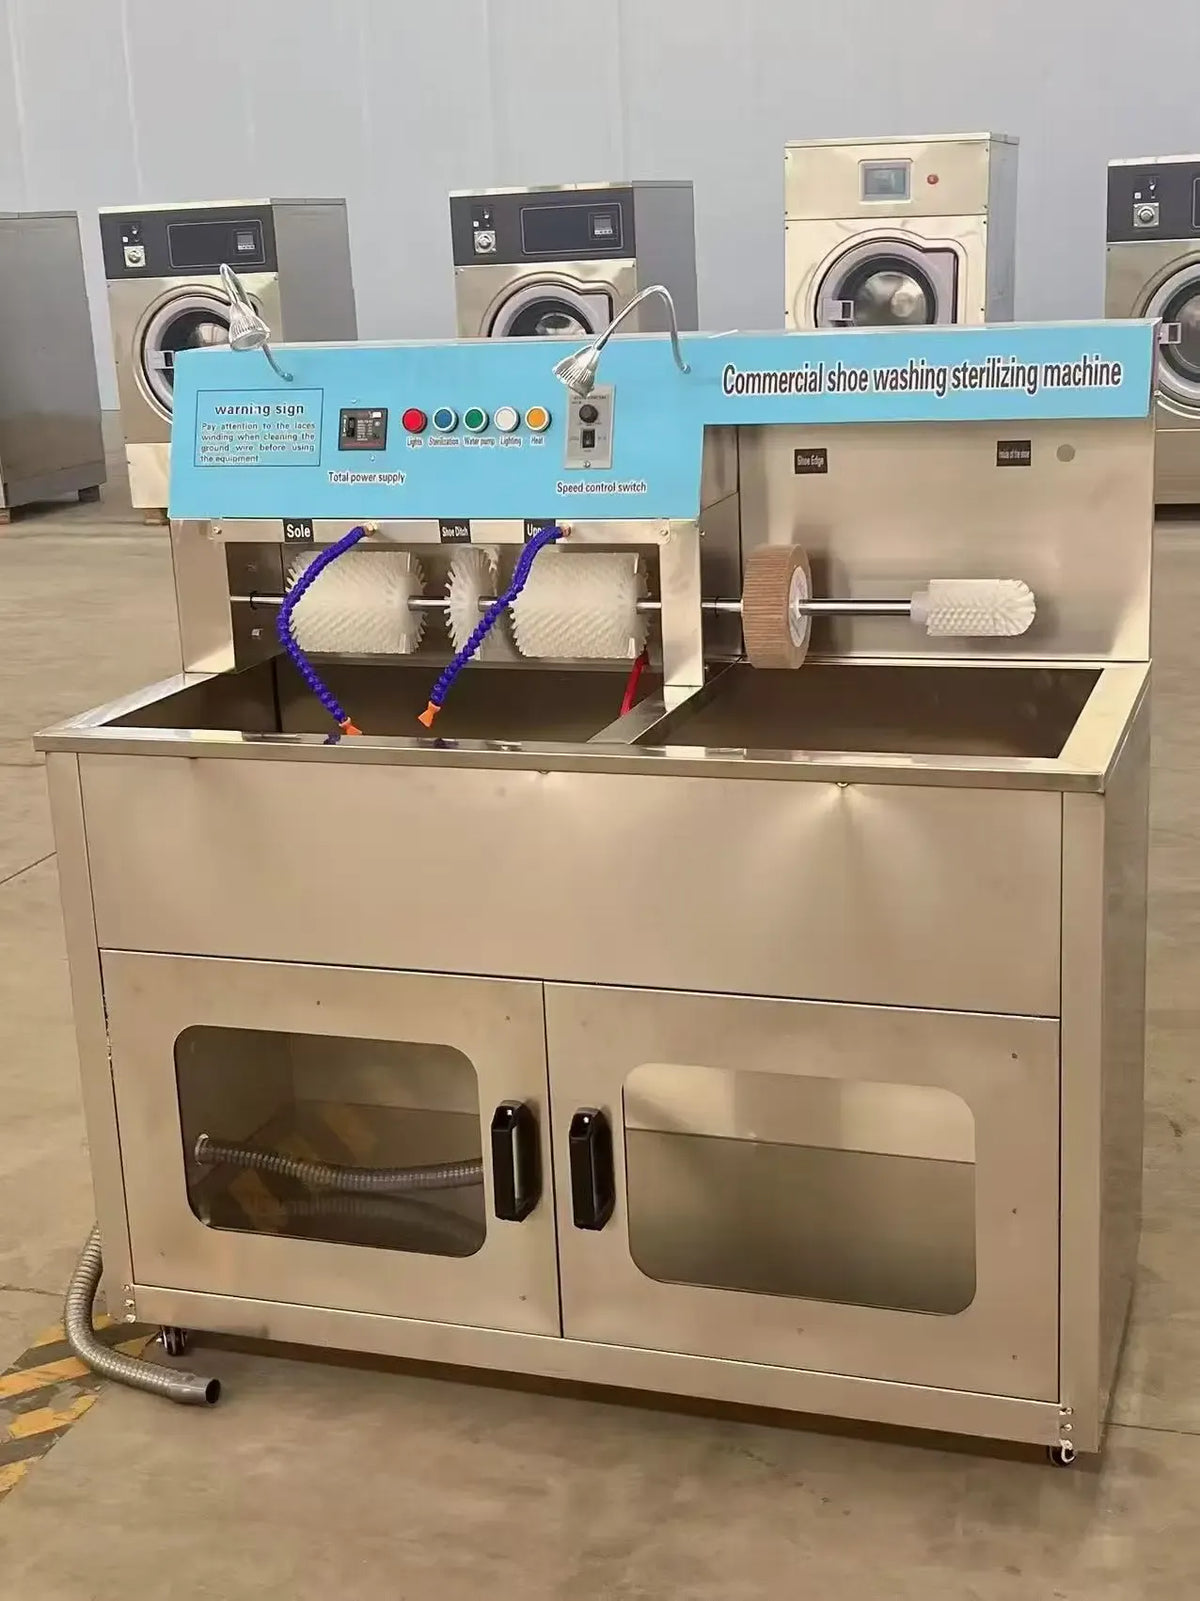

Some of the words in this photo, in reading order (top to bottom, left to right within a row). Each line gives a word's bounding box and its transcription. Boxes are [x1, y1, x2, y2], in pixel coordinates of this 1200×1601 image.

[723, 363, 823, 394] Commercial
[827, 362, 868, 391] shoe
[873, 360, 947, 397] washing
[952, 357, 1038, 394] sterilizing
[1043, 355, 1121, 386] machine
[215, 403, 270, 416] warning
[275, 403, 304, 416] sign
[202, 423, 216, 431] Pay
[221, 422, 258, 430] attention
[202, 433, 233, 442] winding
[263, 433, 297, 441] cleaning
[500, 436, 522, 447] Lighting
[201, 444, 229, 452] ground
[292, 443, 315, 452] using
[328, 472, 349, 482] Total
[350, 474, 376, 484] power
[379, 472, 405, 484] supply
[557, 482, 583, 494] Speed
[585, 482, 616, 492] control
[618, 481, 646, 492] switch
[287, 524, 310, 537] Sole
[442, 527, 454, 537] Shoe
